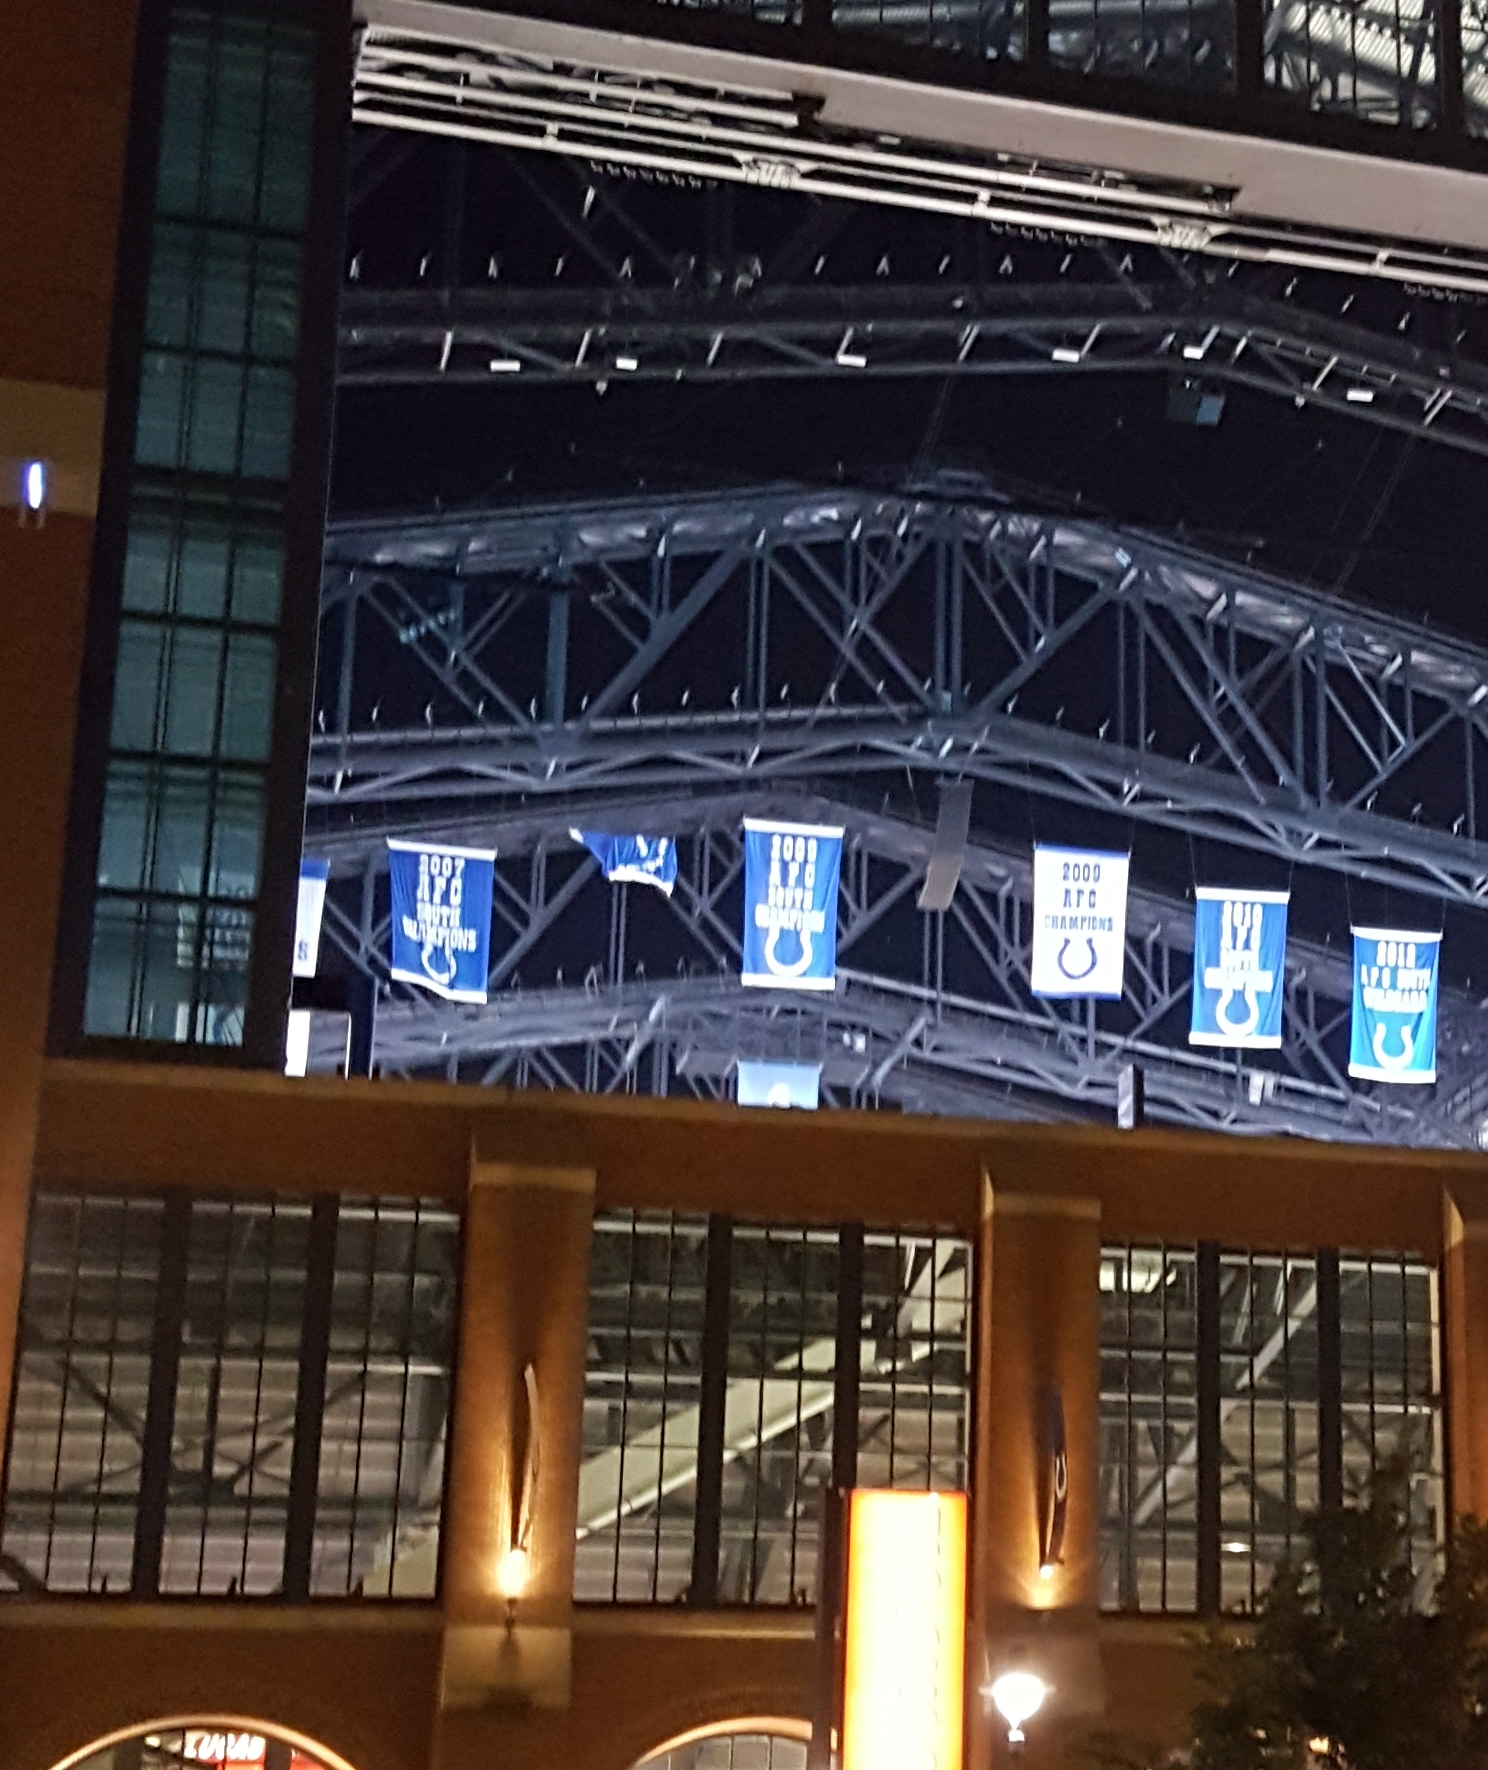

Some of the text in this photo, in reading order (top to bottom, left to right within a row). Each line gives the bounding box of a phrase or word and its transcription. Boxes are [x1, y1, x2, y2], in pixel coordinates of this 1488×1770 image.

[419, 854, 465, 878] 2007
[417, 874, 462, 906] AFC
[1063, 887, 1097, 909] AFC
[1044, 914, 1113, 932] CHAMPIONS
